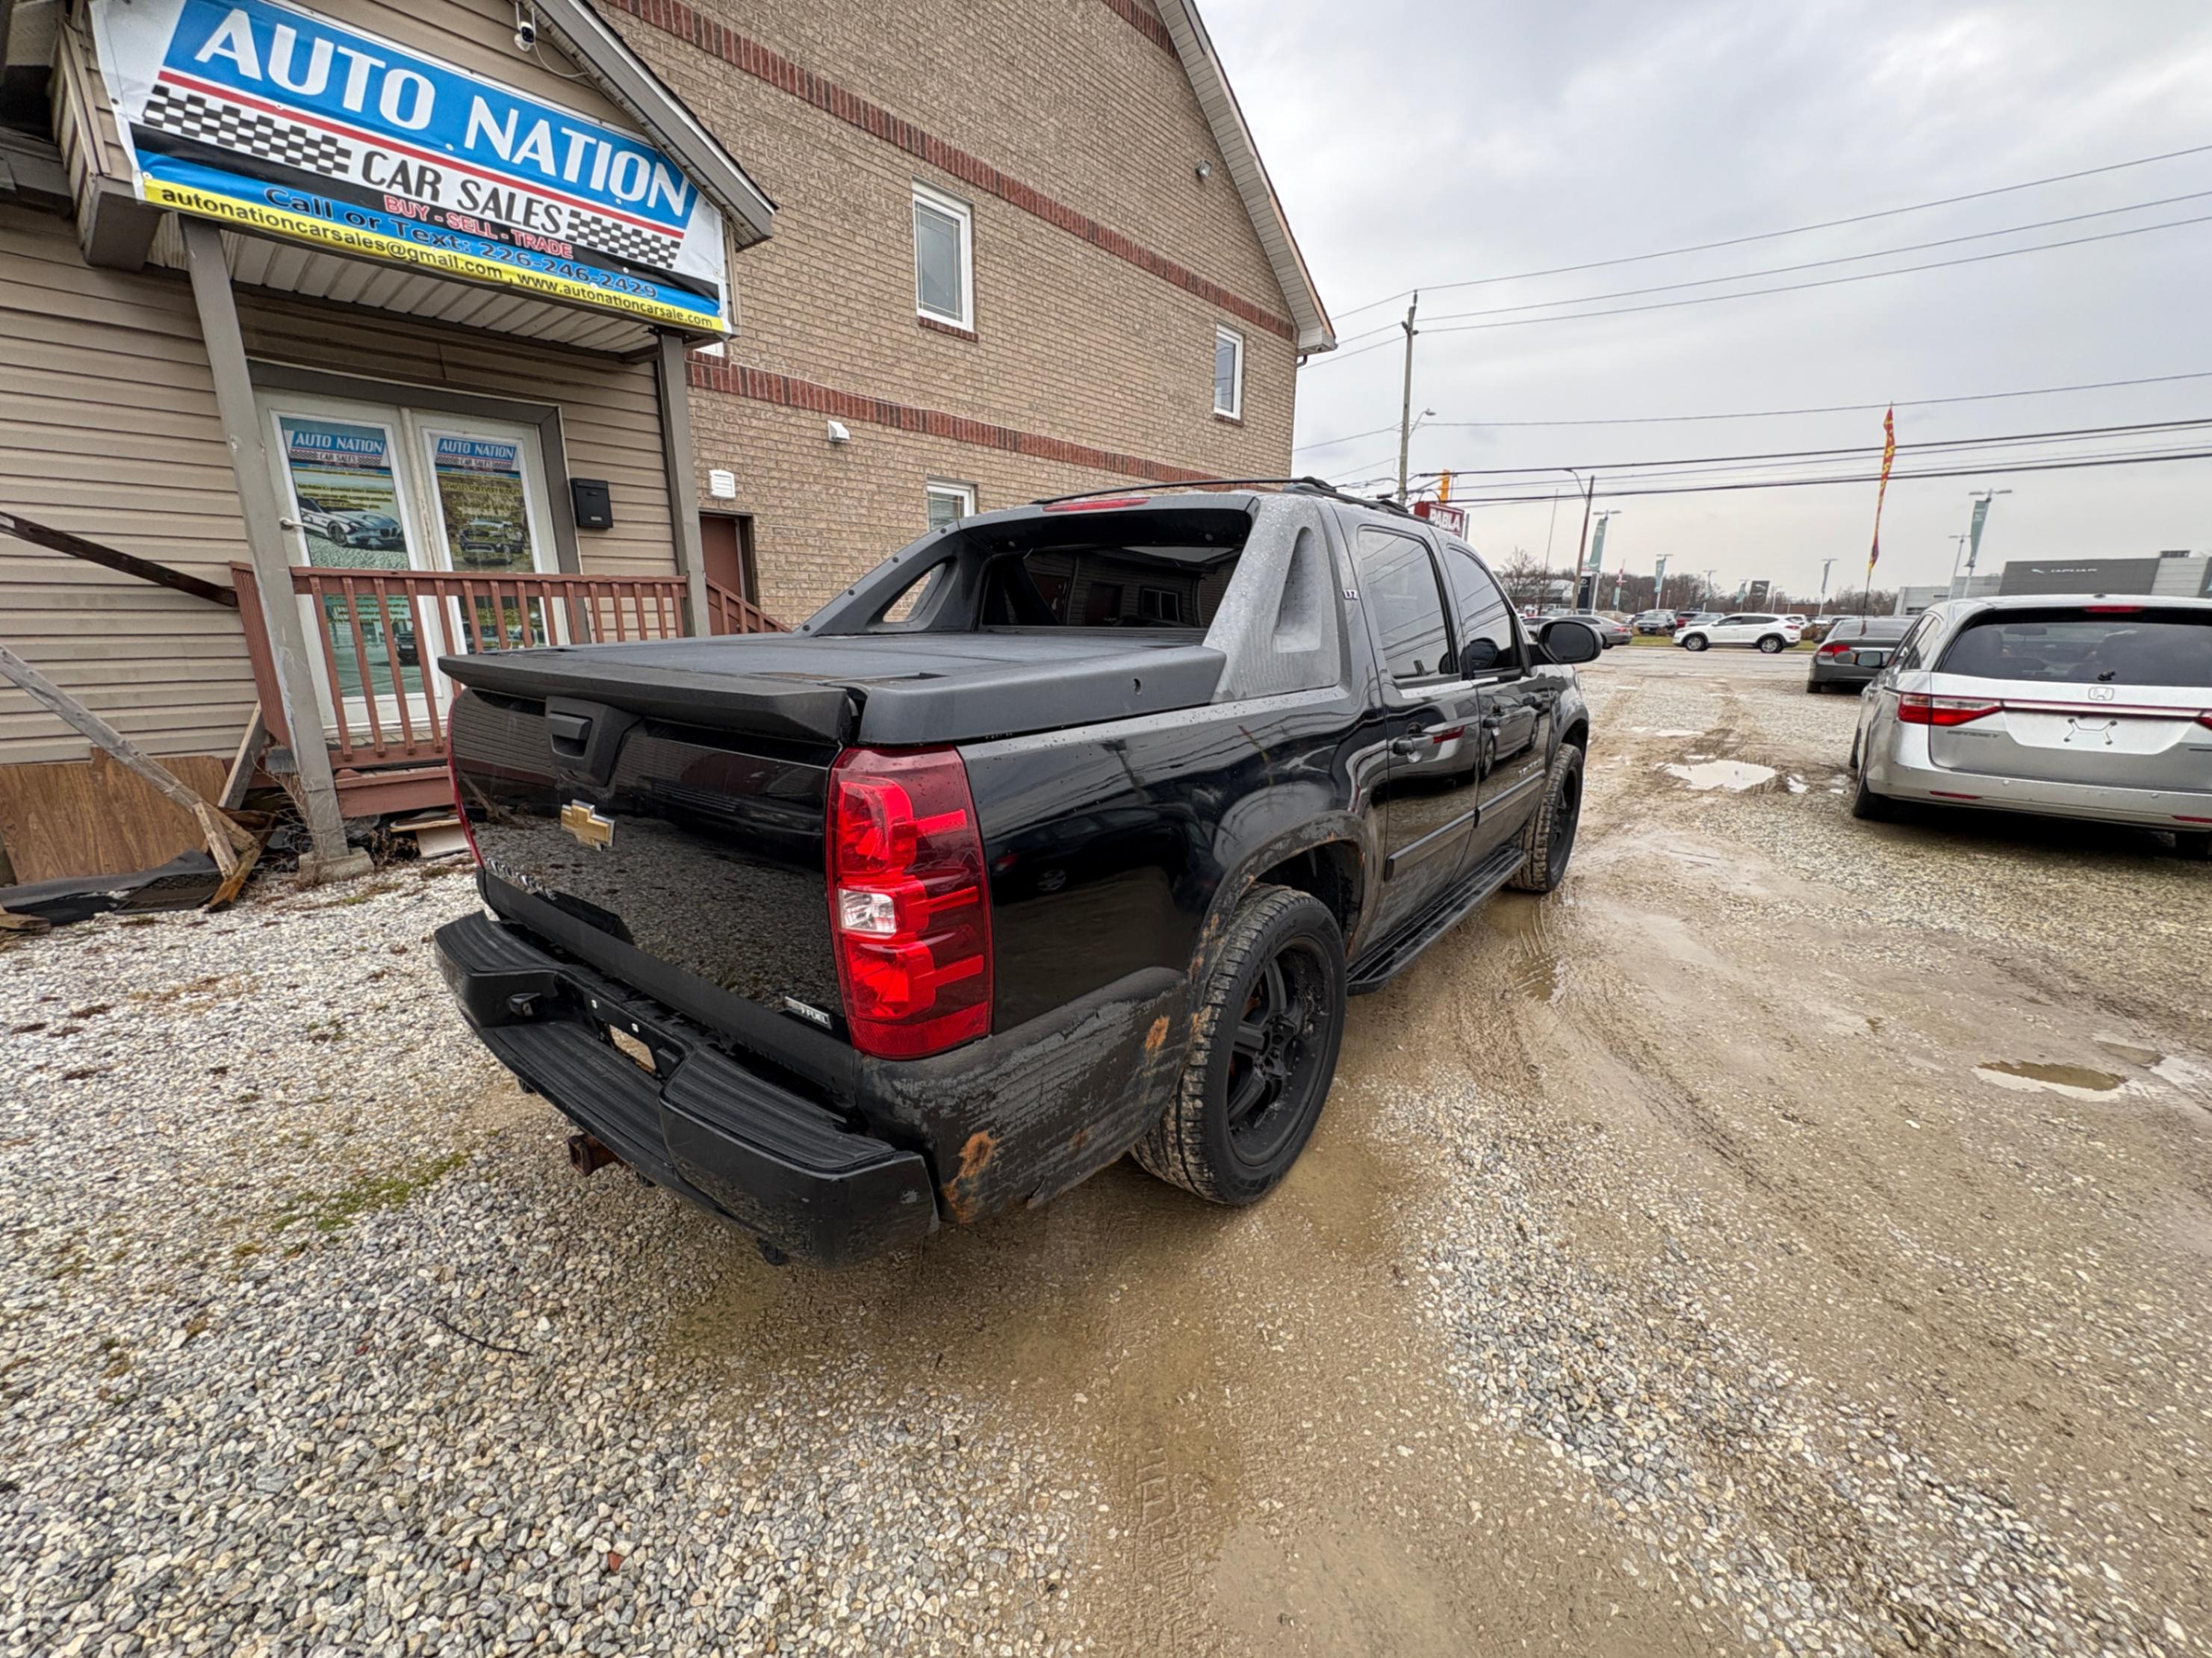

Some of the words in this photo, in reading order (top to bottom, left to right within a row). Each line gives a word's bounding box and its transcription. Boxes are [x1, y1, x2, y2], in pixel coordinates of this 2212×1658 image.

[194, 8, 436, 131] AUTO
[465, 95, 690, 217] NATION
[361, 151, 442, 202] CAR
[457, 179, 563, 235] SALES
[264, 187, 334, 219] Call
[344, 210, 382, 230] or
[389, 217, 470, 252] Text:
[479, 241, 657, 299] 226-246-2429
[384, 193, 430, 222] BUY
[446, 212, 498, 240] SELL
[511, 229, 574, 260] TRADE
[161, 188, 503, 279] autonationcarsales@gmail.com
[517, 272, 713, 328] www.autonationcarsale.com
[296, 432, 332, 448] AUTO
[336, 437, 383, 453] NATION
[336, 454, 357, 462] SALES
[440, 440, 470, 454] AUTO
[474, 444, 514, 459] NATION
[1429, 508, 1461, 532] PABLA
[806, 1008, 829, 1025] FUEL
